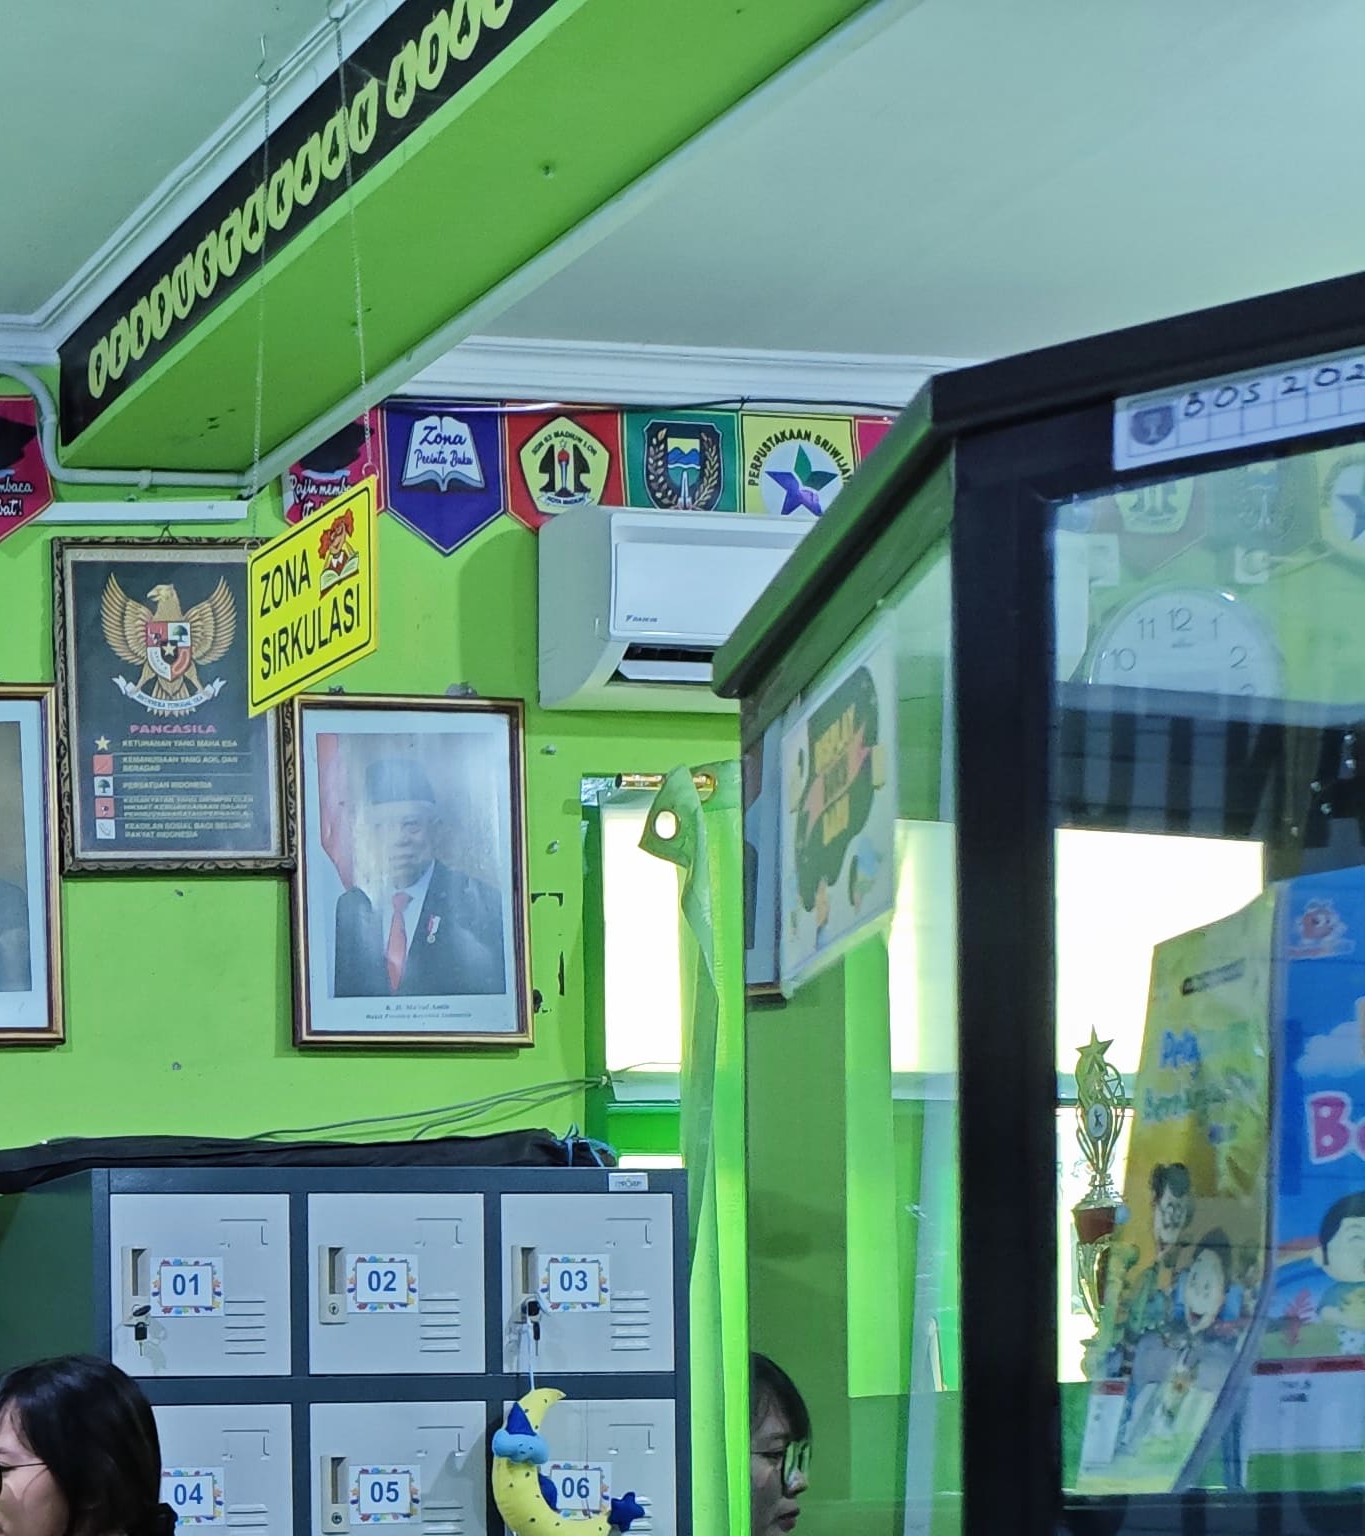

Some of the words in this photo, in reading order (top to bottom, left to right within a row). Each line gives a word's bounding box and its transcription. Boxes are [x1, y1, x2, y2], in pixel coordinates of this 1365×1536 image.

[419, 425, 467, 446] Zona
[414, 449, 447, 468] Pecinta
[449, 449, 473, 467] Buku
[747, 429, 812, 487] PERPUSTAKAAN
[260, 549, 312, 620] ZONA
[1138, 617, 1155, 640] 11
[1168, 607, 1193, 632] 12
[260, 582, 362, 681] SIRKULASI
[1111, 648, 1136, 671] 10
[1230, 646, 1248, 669] 2
[129, 724, 217, 734] PANCASILA
[171, 1273, 200, 1296] 01
[367, 1269, 397, 1293] 02
[559, 1269, 589, 1292] 03
[173, 1483, 203, 1506] 04
[370, 1480, 400, 1504] 05
[560, 1476, 590, 1499] 06
